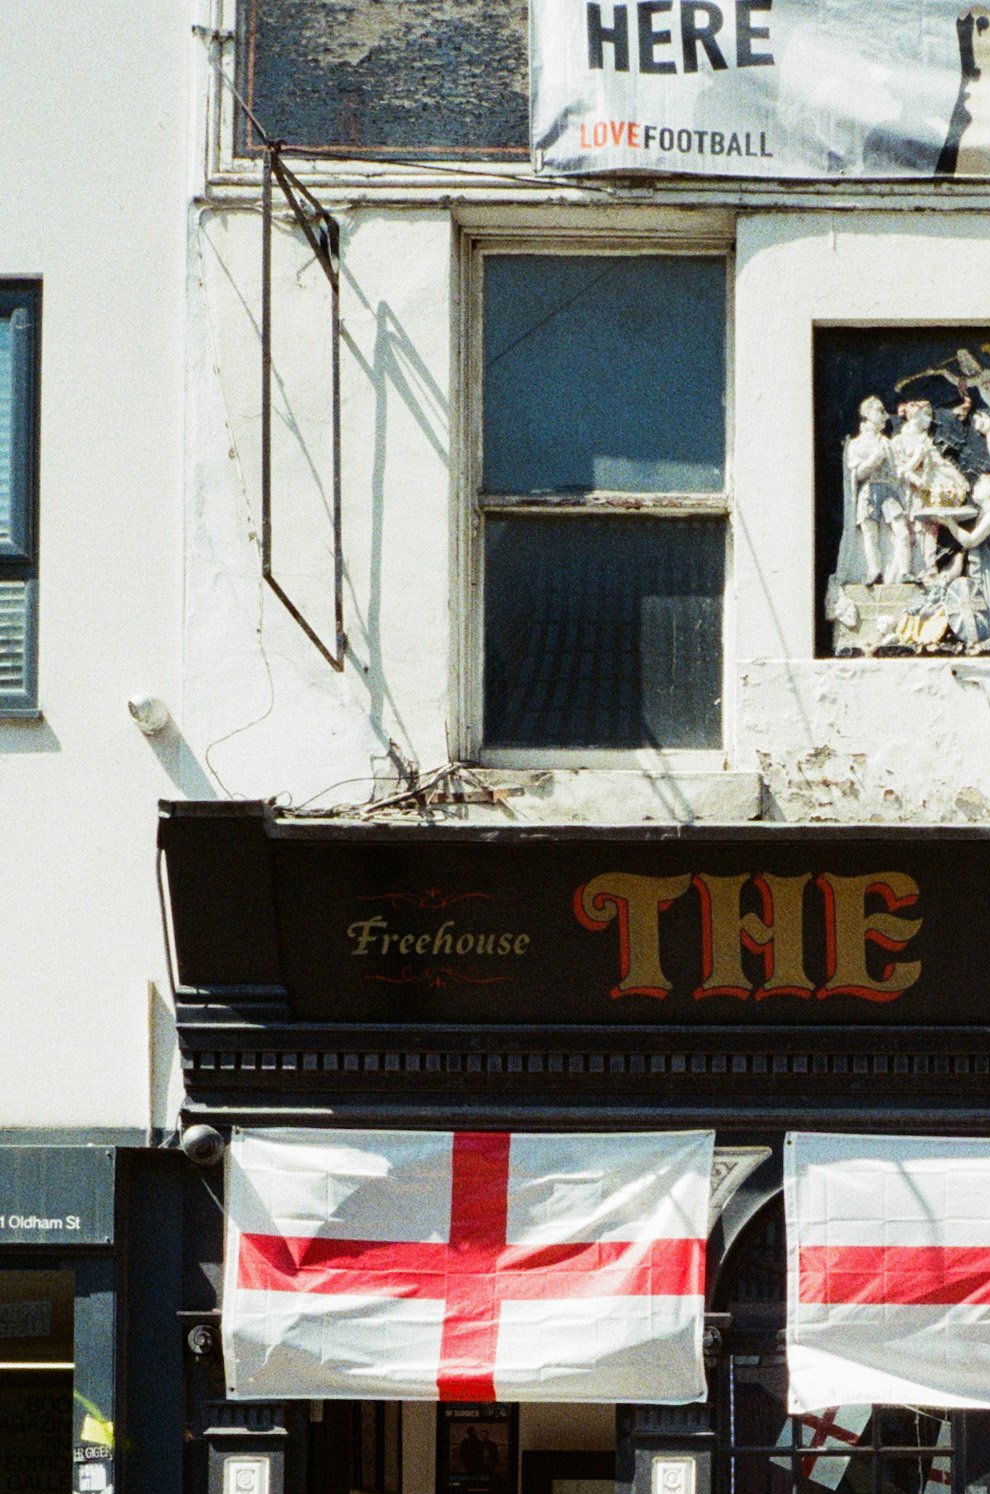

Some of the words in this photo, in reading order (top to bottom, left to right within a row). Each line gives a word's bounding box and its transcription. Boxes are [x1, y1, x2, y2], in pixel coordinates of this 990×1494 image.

[587, 0, 775, 74] HERE
[579, 121, 774, 157] LOVEFOOTBALL
[346, 915, 531, 957] Freehouse
[573, 871, 924, 1001] THE
[9, 1214, 63, 1230] Oldham
[65, 1214, 81, 1230] St
